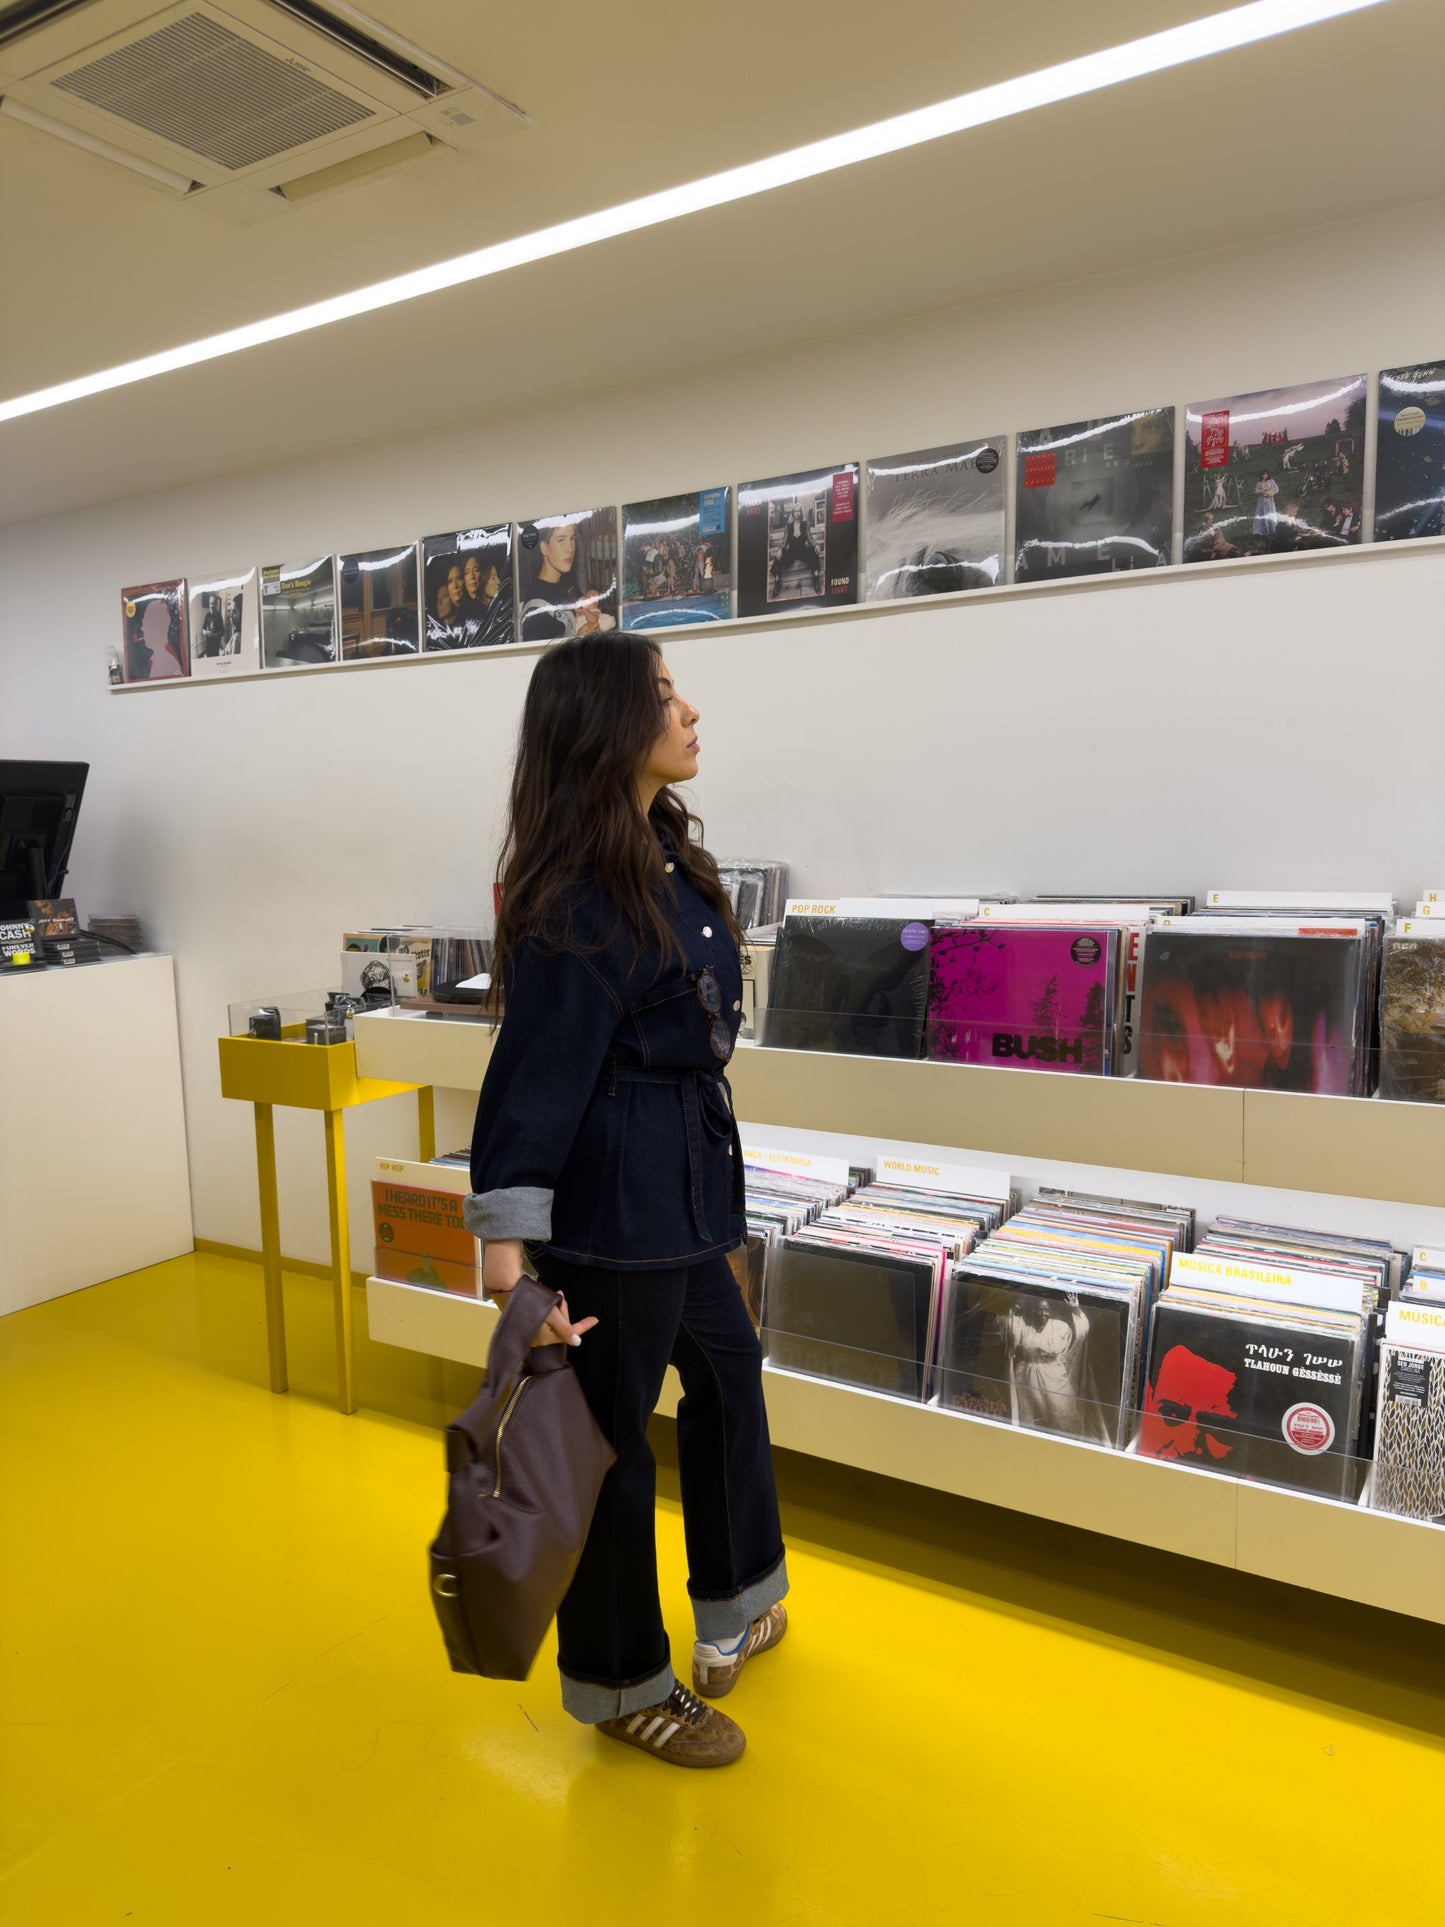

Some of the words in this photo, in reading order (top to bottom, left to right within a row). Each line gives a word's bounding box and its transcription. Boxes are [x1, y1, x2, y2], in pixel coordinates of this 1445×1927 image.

[830, 577, 850, 586] FOUND
[1213, 894, 1219, 903] E
[1429, 893, 1437, 902] H
[792, 904, 810, 913] POP
[811, 905, 836, 914] ROCK
[983, 907, 990, 917] C
[1422, 905, 1431, 915] G
[1404, 923, 1412, 933] F
[0, 929, 31, 940] CASH
[991, 1032, 1082, 1063] BUSH
[379, 1162, 390, 1170] HIP
[391, 1164, 405, 1173] HOP
[883, 1160, 912, 1172] WORLD
[913, 1164, 940, 1176] MUSIC
[391, 1190, 426, 1209] HEARD
[427, 1196, 447, 1211] IT'S
[449, 1199, 458, 1213] A
[378, 1203, 406, 1220] MESS
[407, 1208, 443, 1226] THERE
[1419, 1251, 1427, 1262] C
[1225, 1266, 1292, 1285] BRASILEIRA
[1244, 1358, 1290, 1375] TLAHOUN
